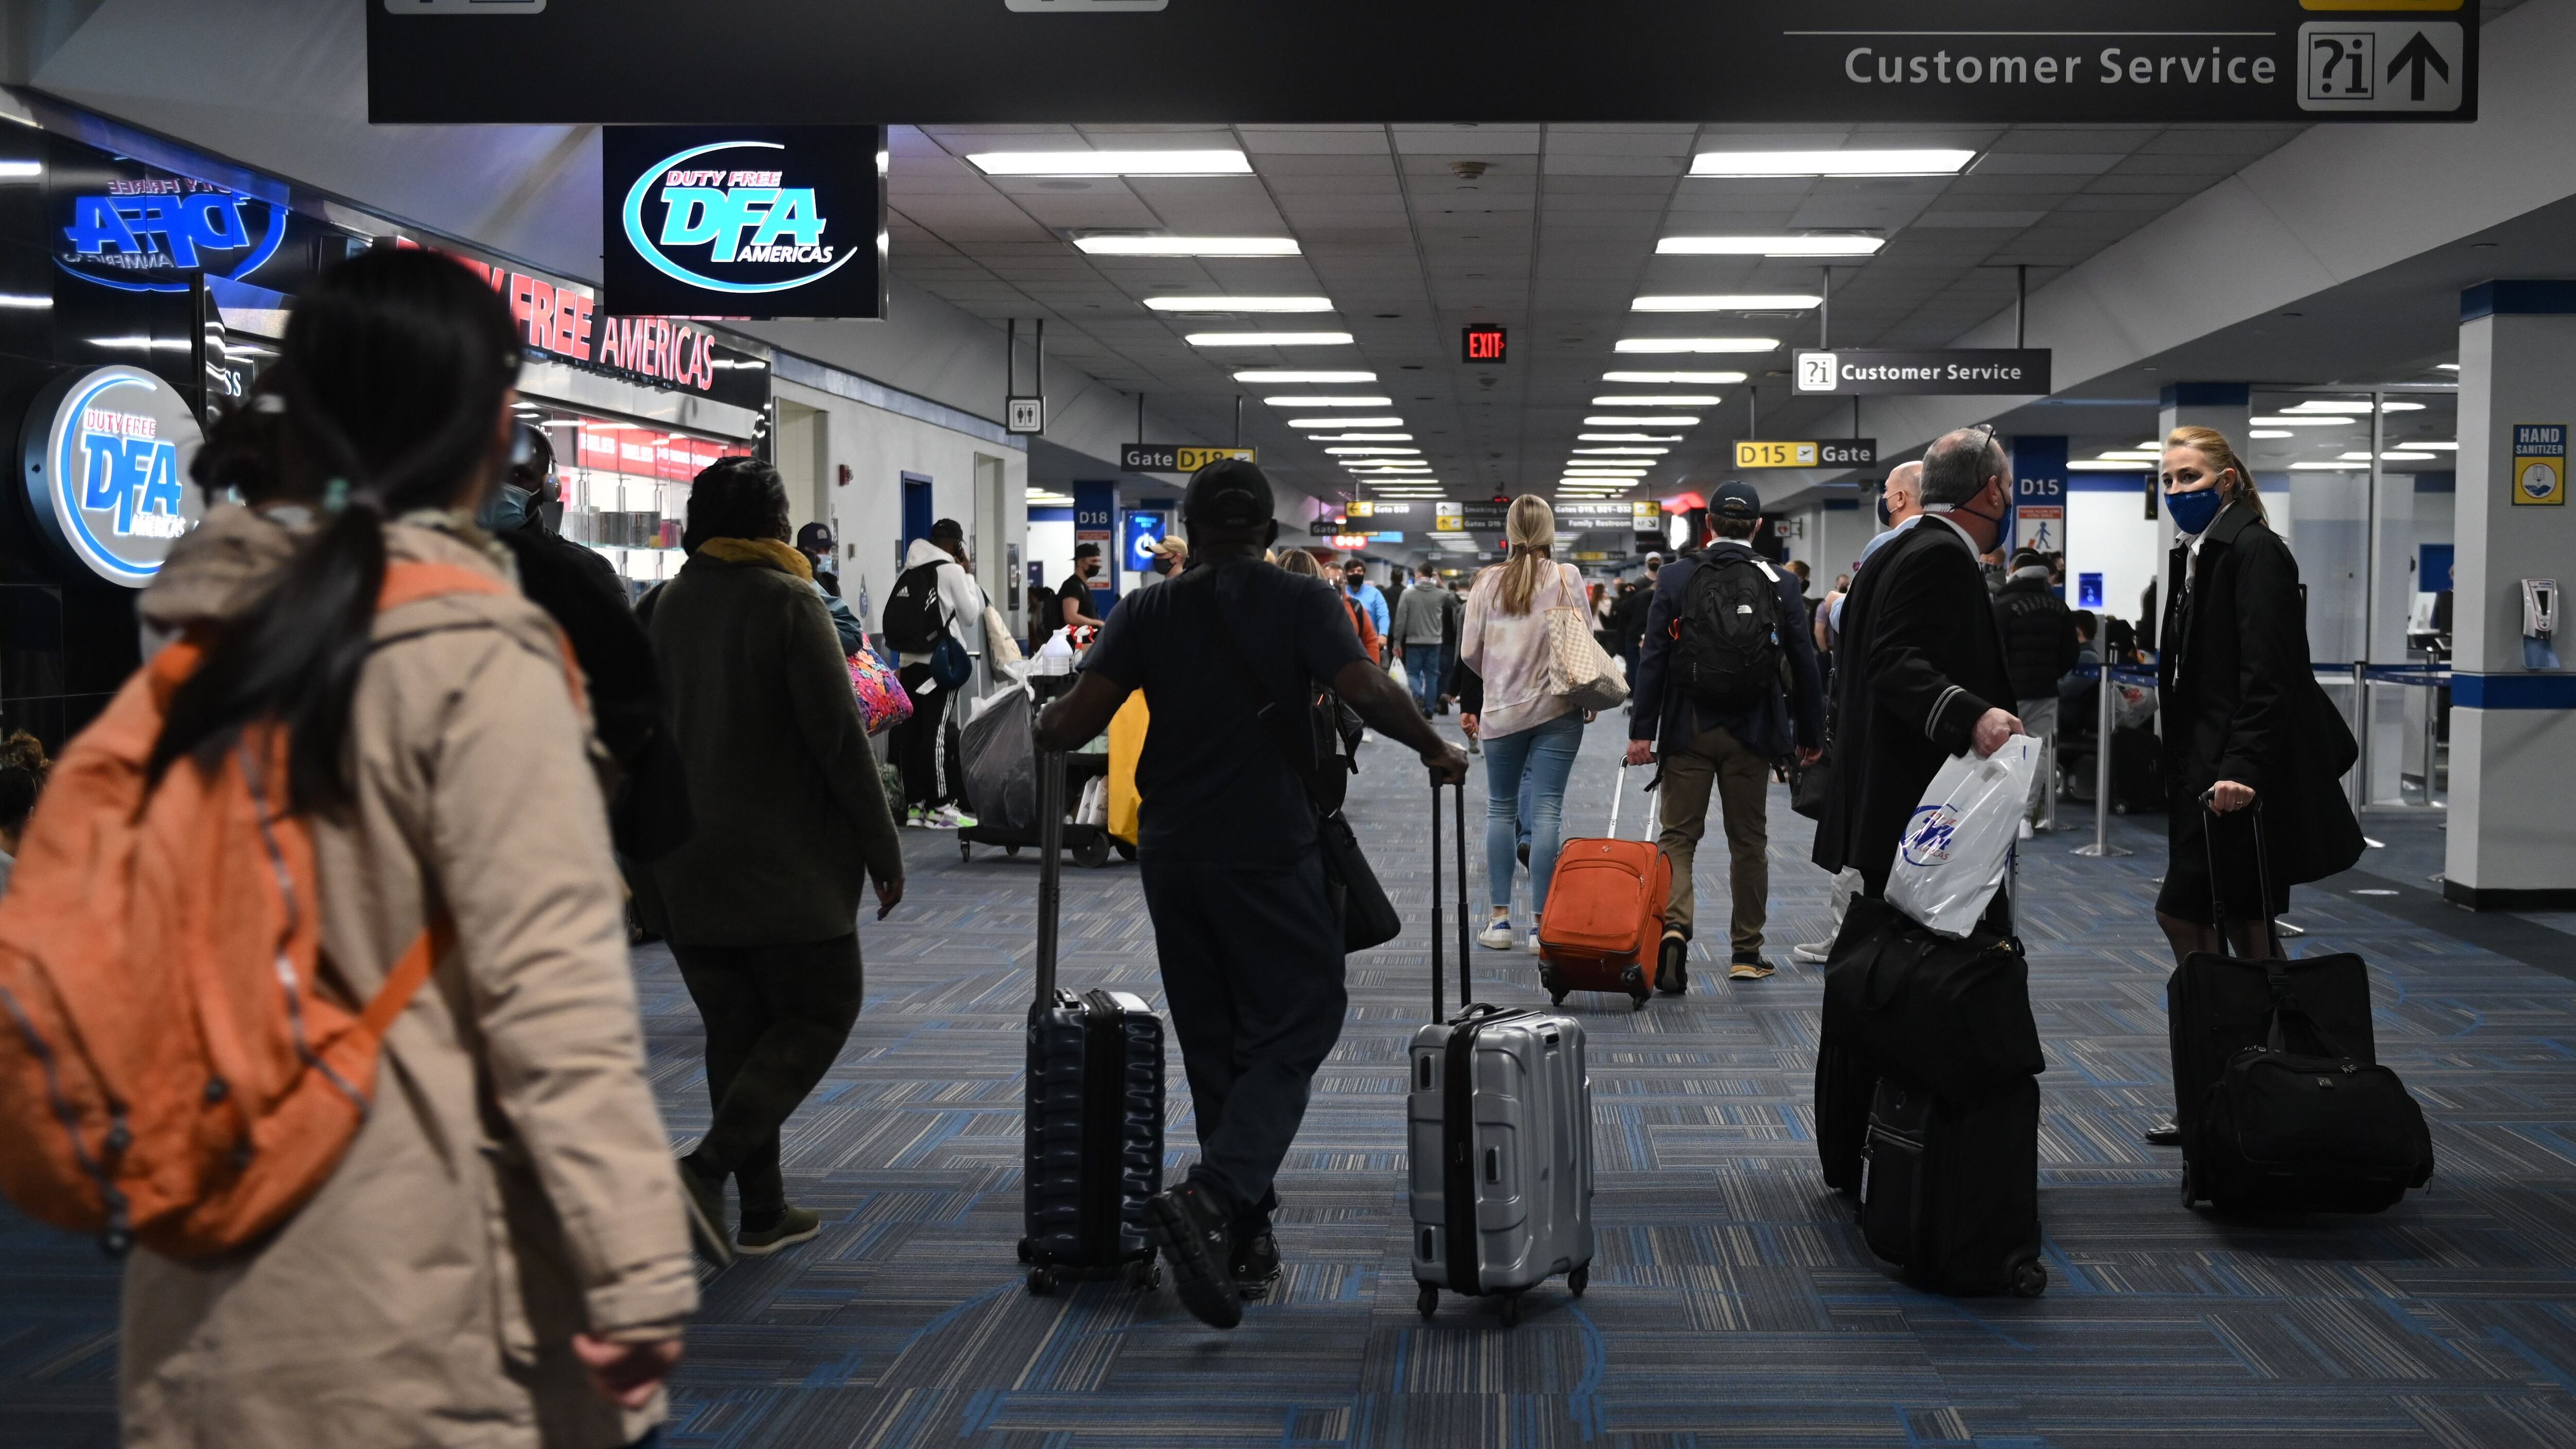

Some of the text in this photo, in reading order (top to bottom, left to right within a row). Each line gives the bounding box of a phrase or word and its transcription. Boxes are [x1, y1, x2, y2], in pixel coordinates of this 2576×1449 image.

[1845, 46, 2276, 83] Customer Service
[666, 171, 783, 187] DUTY FREE
[660, 188, 826, 262] DFA
[737, 246, 834, 263] AMERICAS
[510, 273, 715, 391] FREE AMERICAS
[1469, 333, 1501, 358] EXIT
[1841, 364, 2022, 380] Customer Service
[84, 409, 156, 437] DUTY FREE
[2520, 428, 2560, 443] HAND
[1741, 446, 1871, 462] D15 Gate
[2516, 445, 2563, 454] SANITIZER
[1127, 451, 1173, 466] Gate
[81, 431, 182, 535] DFA
[2021, 479, 2059, 495] D15
[1079, 512, 1107, 524] D18
